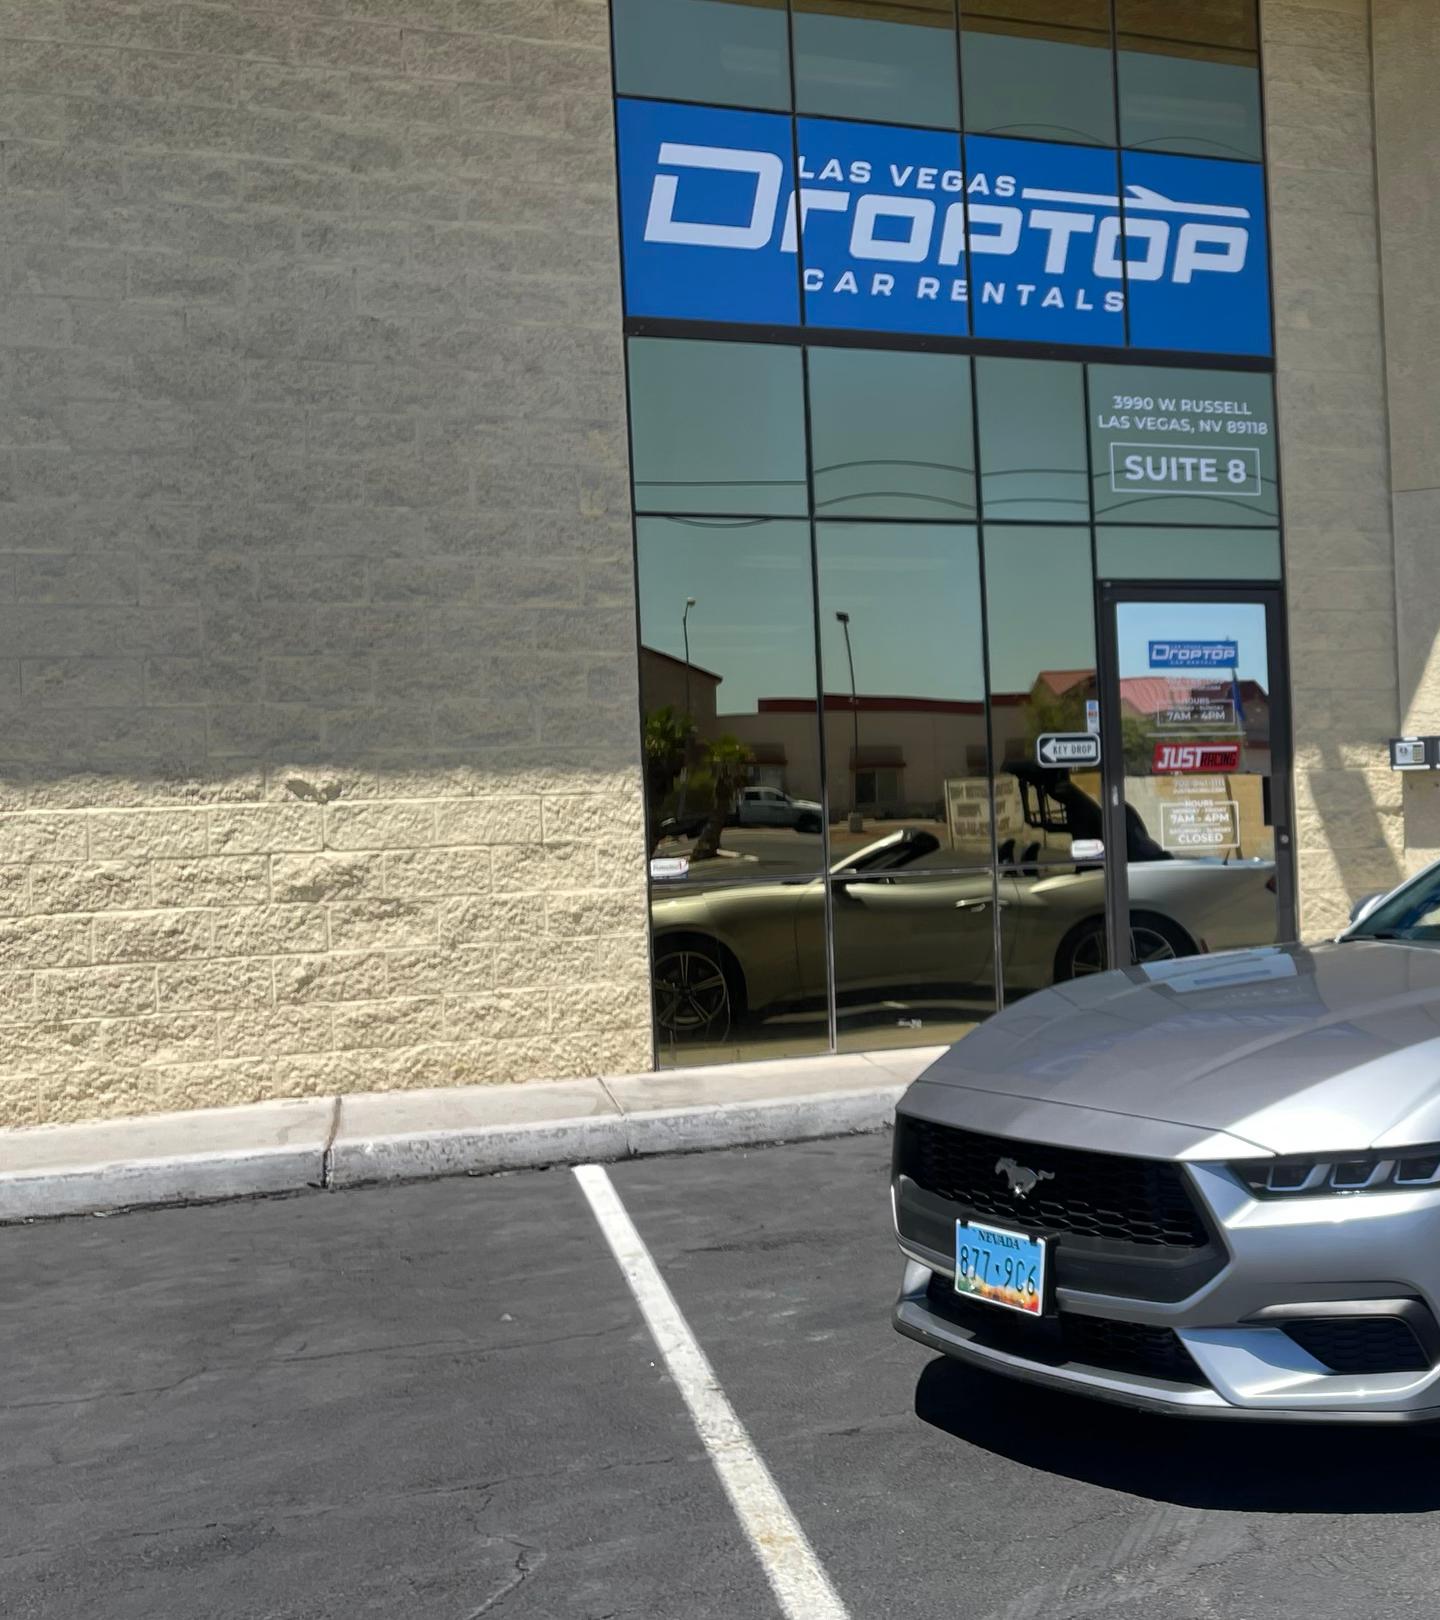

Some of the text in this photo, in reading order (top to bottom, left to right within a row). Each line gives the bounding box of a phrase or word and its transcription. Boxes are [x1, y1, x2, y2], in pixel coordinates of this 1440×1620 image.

[797, 155, 1018, 199] LAS VEGAS
[802, 269, 1126, 313] CAR RENTALS
[1113, 395, 1154, 410] 3990
[1181, 399, 1252, 415] RUSSELL
[1098, 415, 1268, 435] LAS VEGAS, NV 89118
[1125, 455, 1247, 484] SUITE 8
[1168, 711, 1191, 721] 7AM
[1201, 710, 1225, 720] 4PM
[1053, 744, 1092, 755] KEY DROP
[1158, 746, 1203, 768] JUST
[1170, 814, 1195, 824] 7AM
[1204, 812, 1229, 822] 4PM
[1178, 832, 1224, 845] CLOSED
[978, 1230, 1020, 1250] NEVADA
